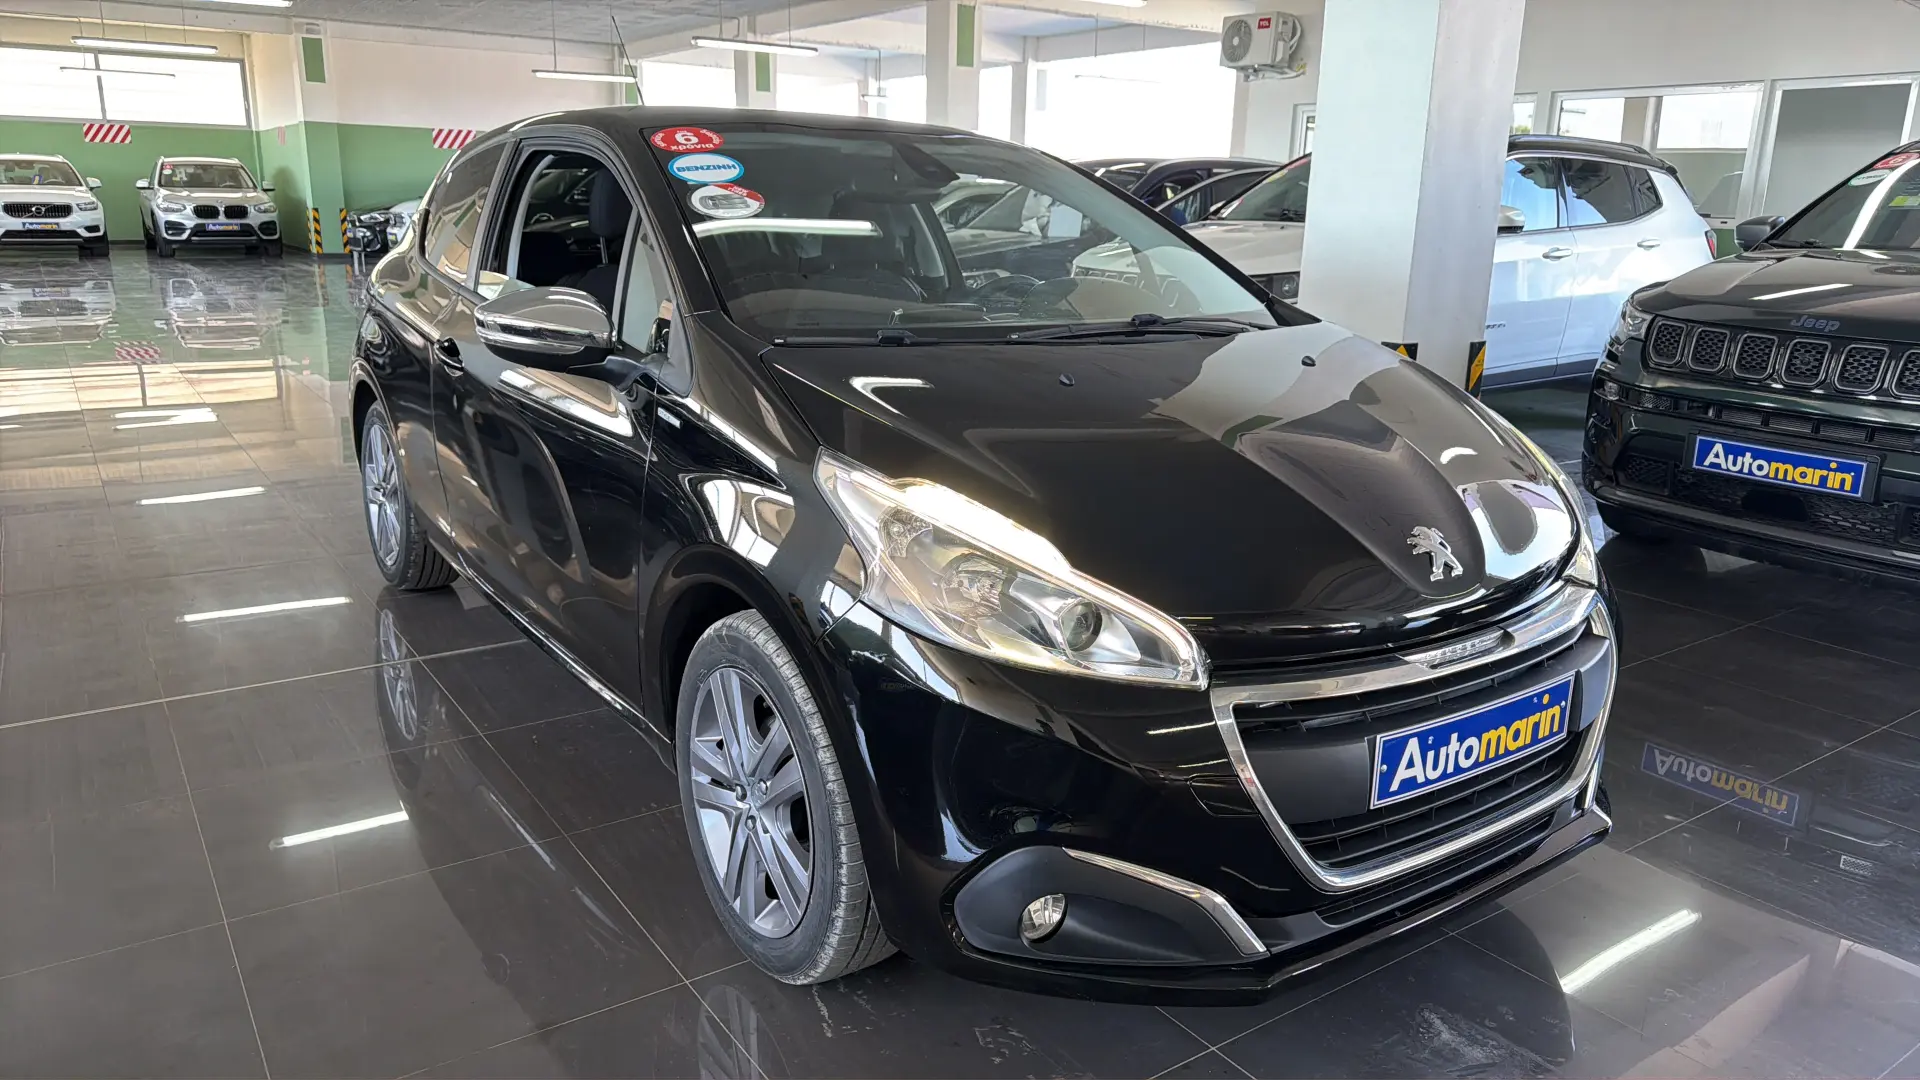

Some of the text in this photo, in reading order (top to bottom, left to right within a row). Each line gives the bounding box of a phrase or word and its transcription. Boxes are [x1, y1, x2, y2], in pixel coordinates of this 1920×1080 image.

[675, 132, 699, 144] 6
[671, 143, 714, 151] χρόνια
[676, 163, 737, 173] ΒΕΝΖΙΝΗ
[1790, 315, 1840, 332] Jeep
[1703, 442, 1853, 491] Automarin
[1389, 693, 1561, 792] Automarin
